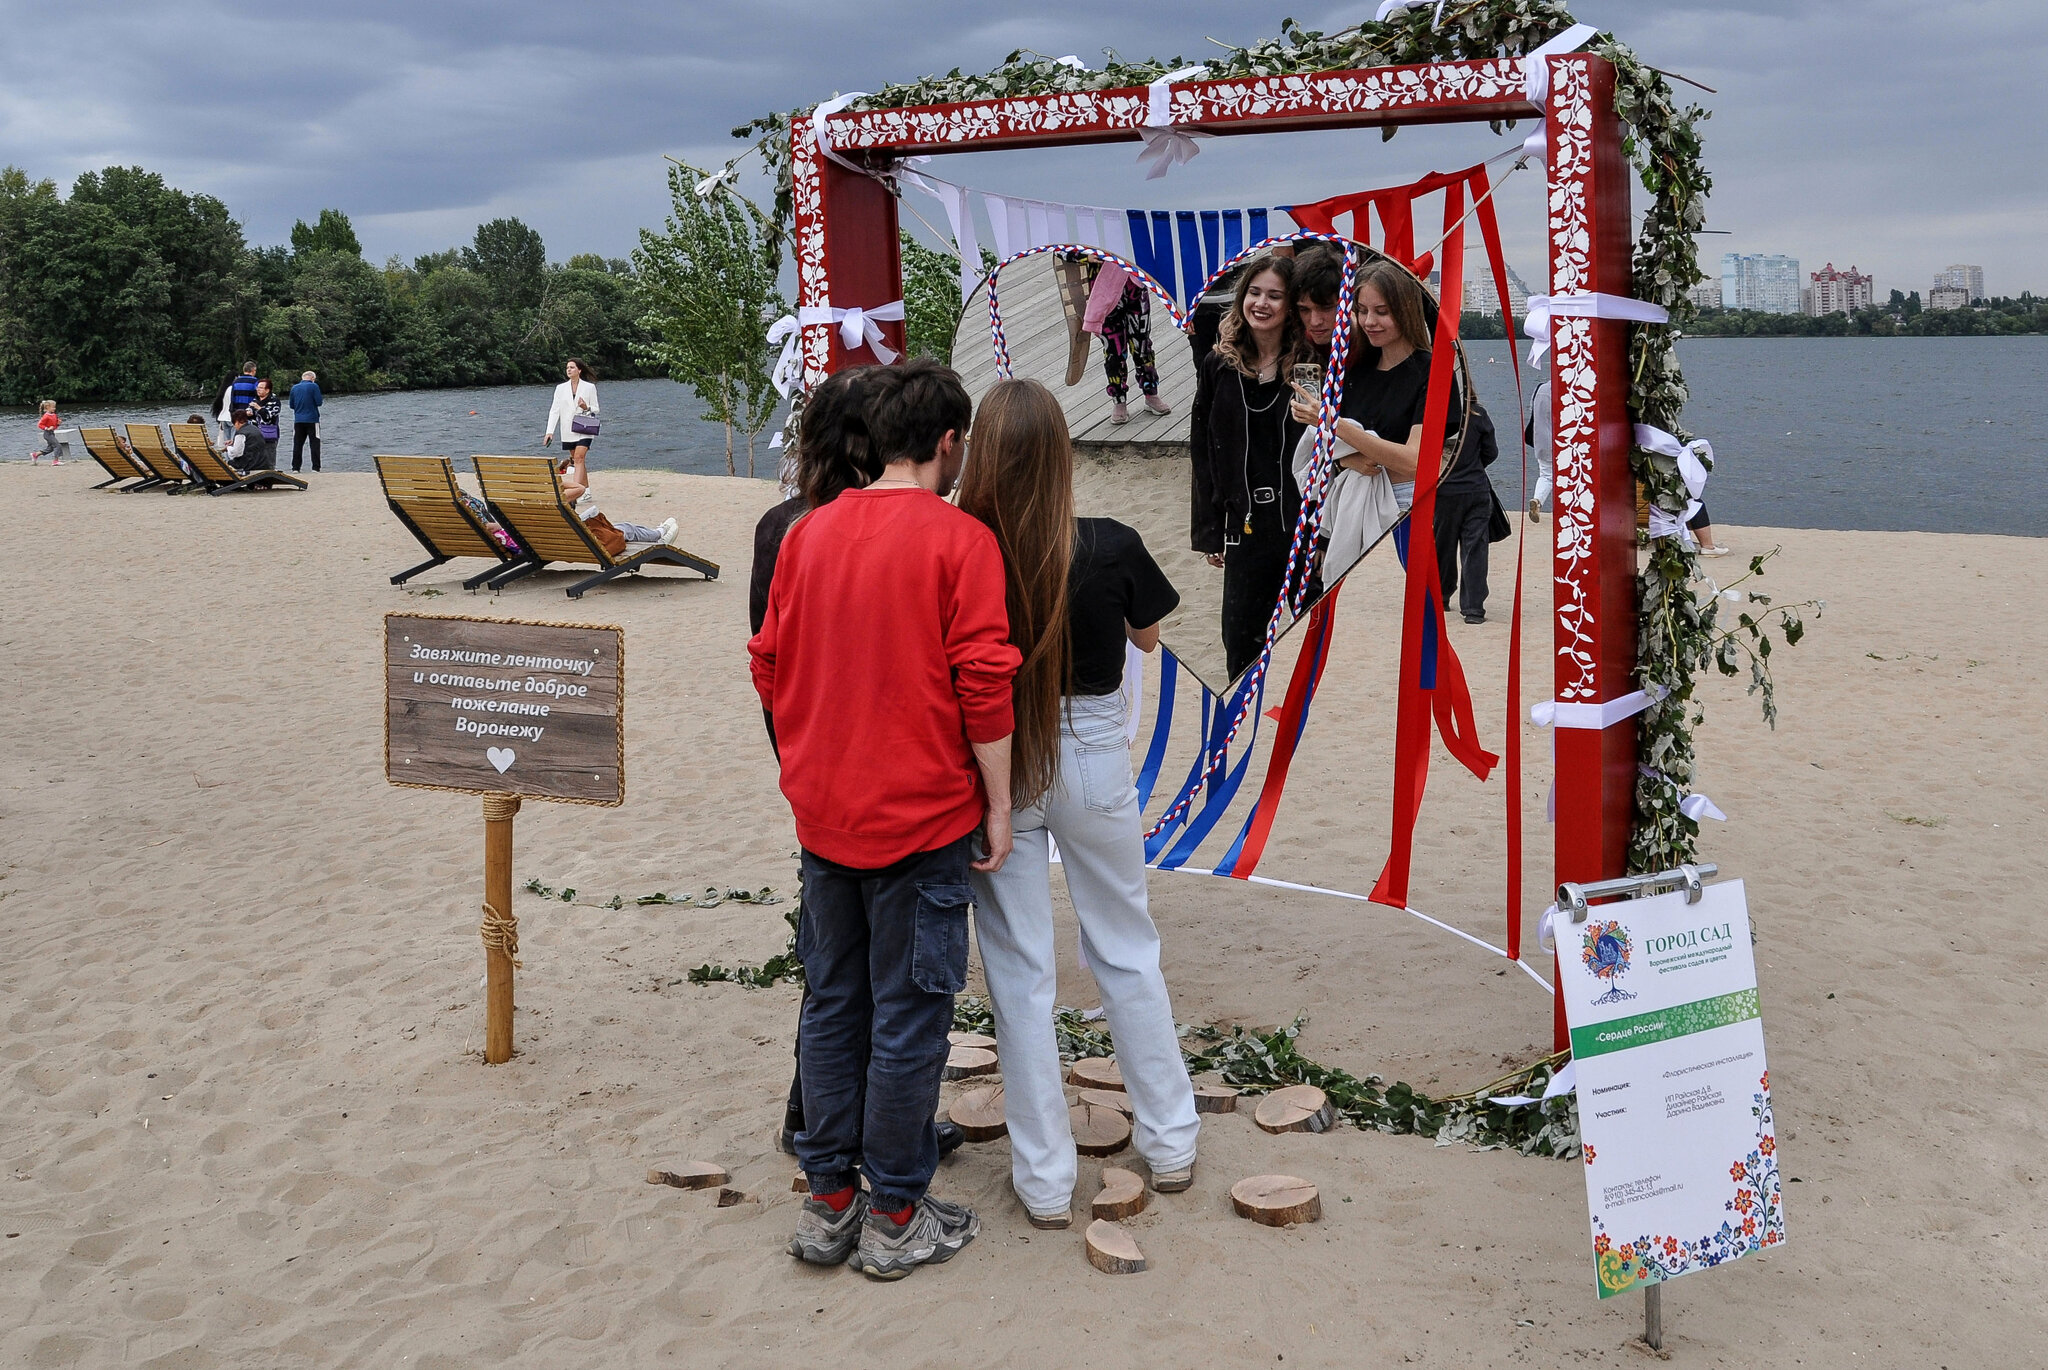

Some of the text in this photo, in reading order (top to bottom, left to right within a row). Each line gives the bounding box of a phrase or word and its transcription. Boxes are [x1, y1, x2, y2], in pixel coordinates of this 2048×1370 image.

[410, 644, 594, 676] Завяжите ленточку
[413, 671, 588, 699] и оставьте доброе
[451, 697, 550, 717] пожелание
[455, 717, 544, 742] Воронежу
[1645, 923, 1733, 955] ГОРОД САД
[1649, 943, 1733, 967] Воронежский международный
[1658, 964, 1687, 975] фестиваль
[1688, 959, 1705, 968] садов
[1709, 954, 1727, 964] цветов
[1592, 1081, 1632, 1096] Номинация:
[1595, 1106, 1628, 1120] Участник:
